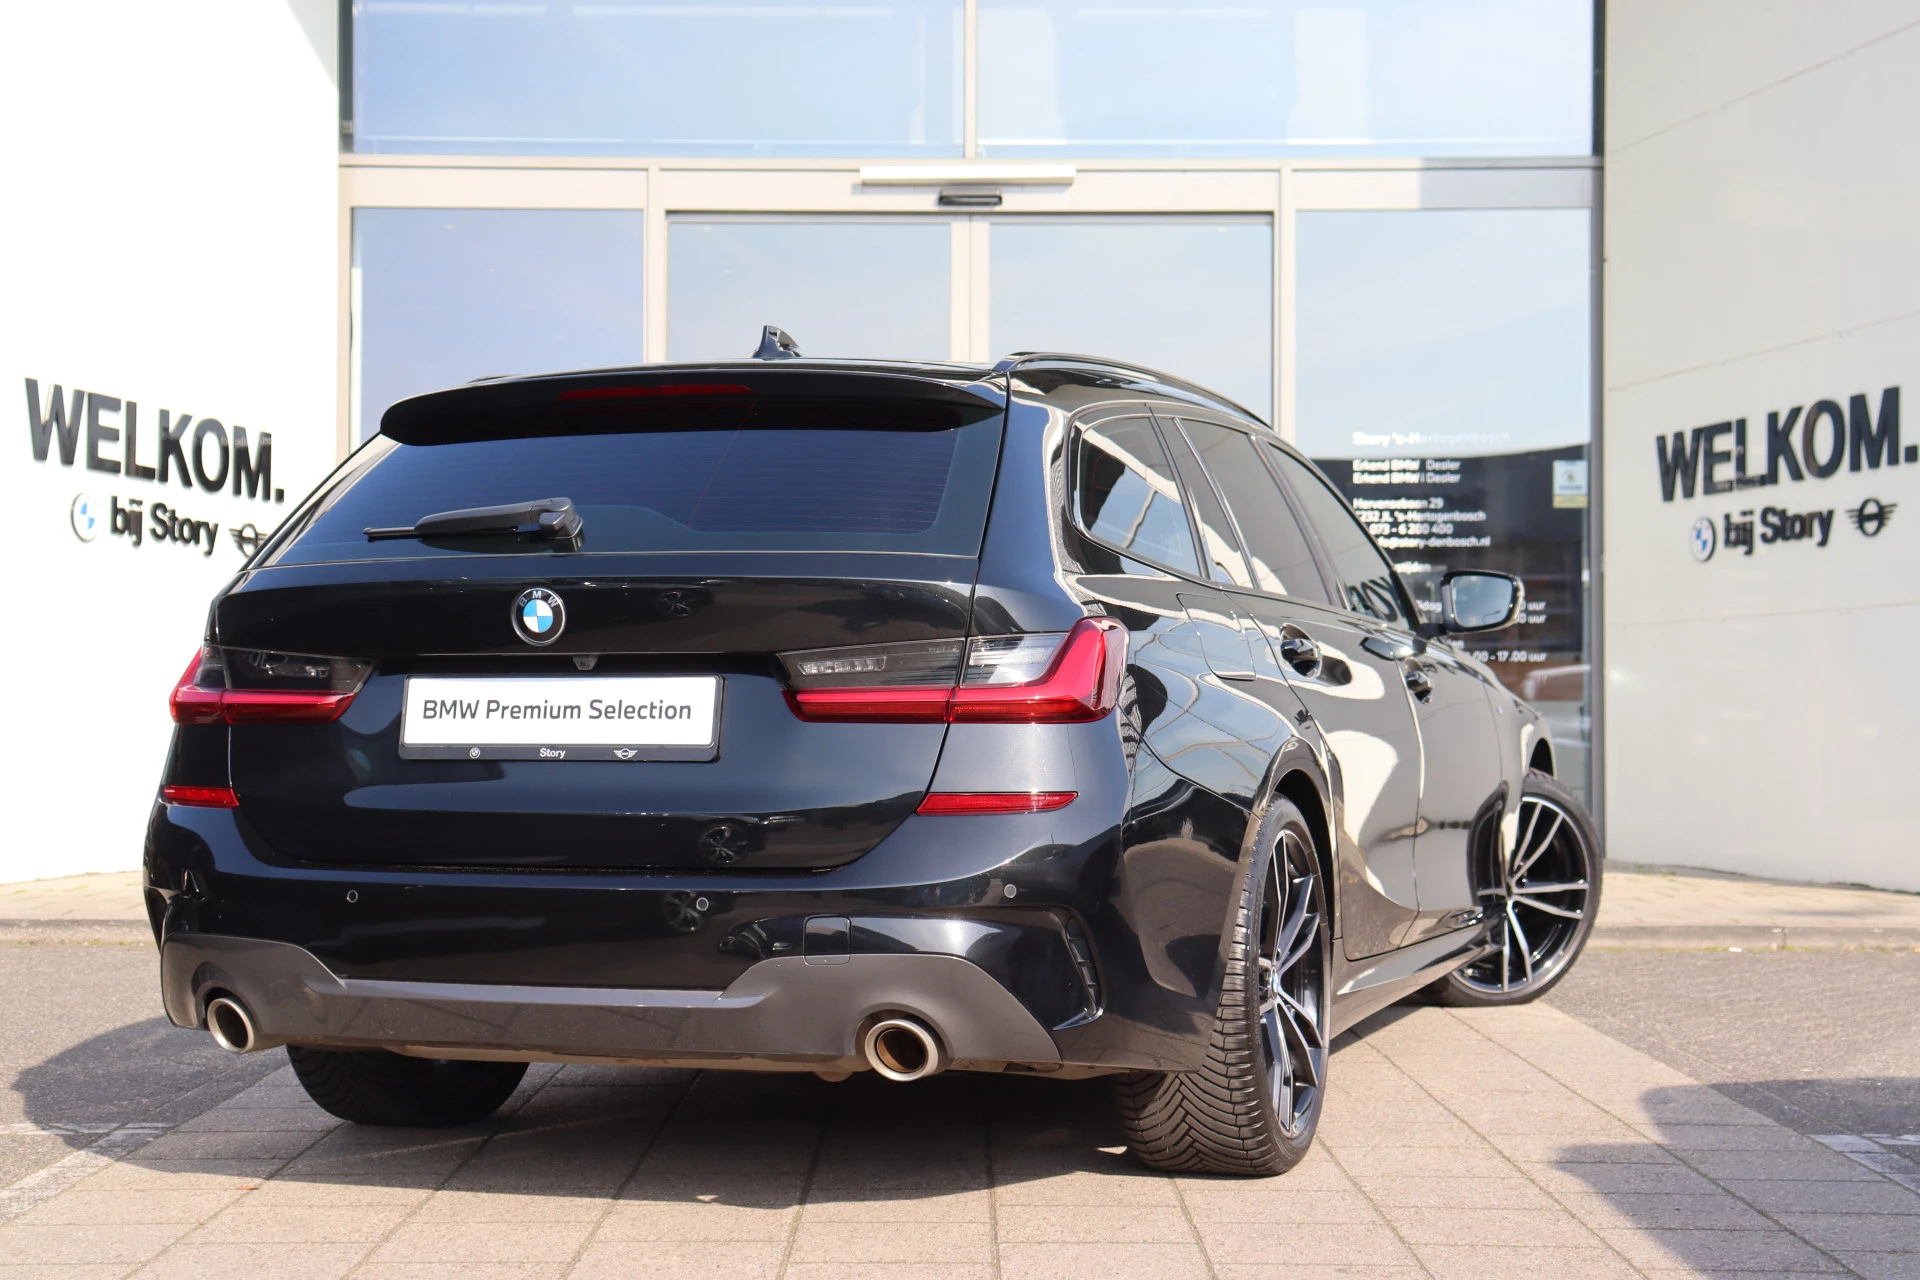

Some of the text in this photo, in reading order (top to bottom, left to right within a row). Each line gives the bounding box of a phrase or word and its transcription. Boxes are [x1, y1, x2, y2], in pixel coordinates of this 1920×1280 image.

[25, 377, 284, 503] WELKOM.
[1656, 386, 1919, 502] WELKOM.
[1425, 459, 1461, 471] Dealer
[1425, 472, 1461, 484] Dealer
[110, 496, 218, 556] bij Story
[1724, 506, 1834, 555] bij Story
[518, 590, 559, 608] BMW
[422, 698, 692, 720] BMW Premium Selection
[539, 747, 566, 759] Story
